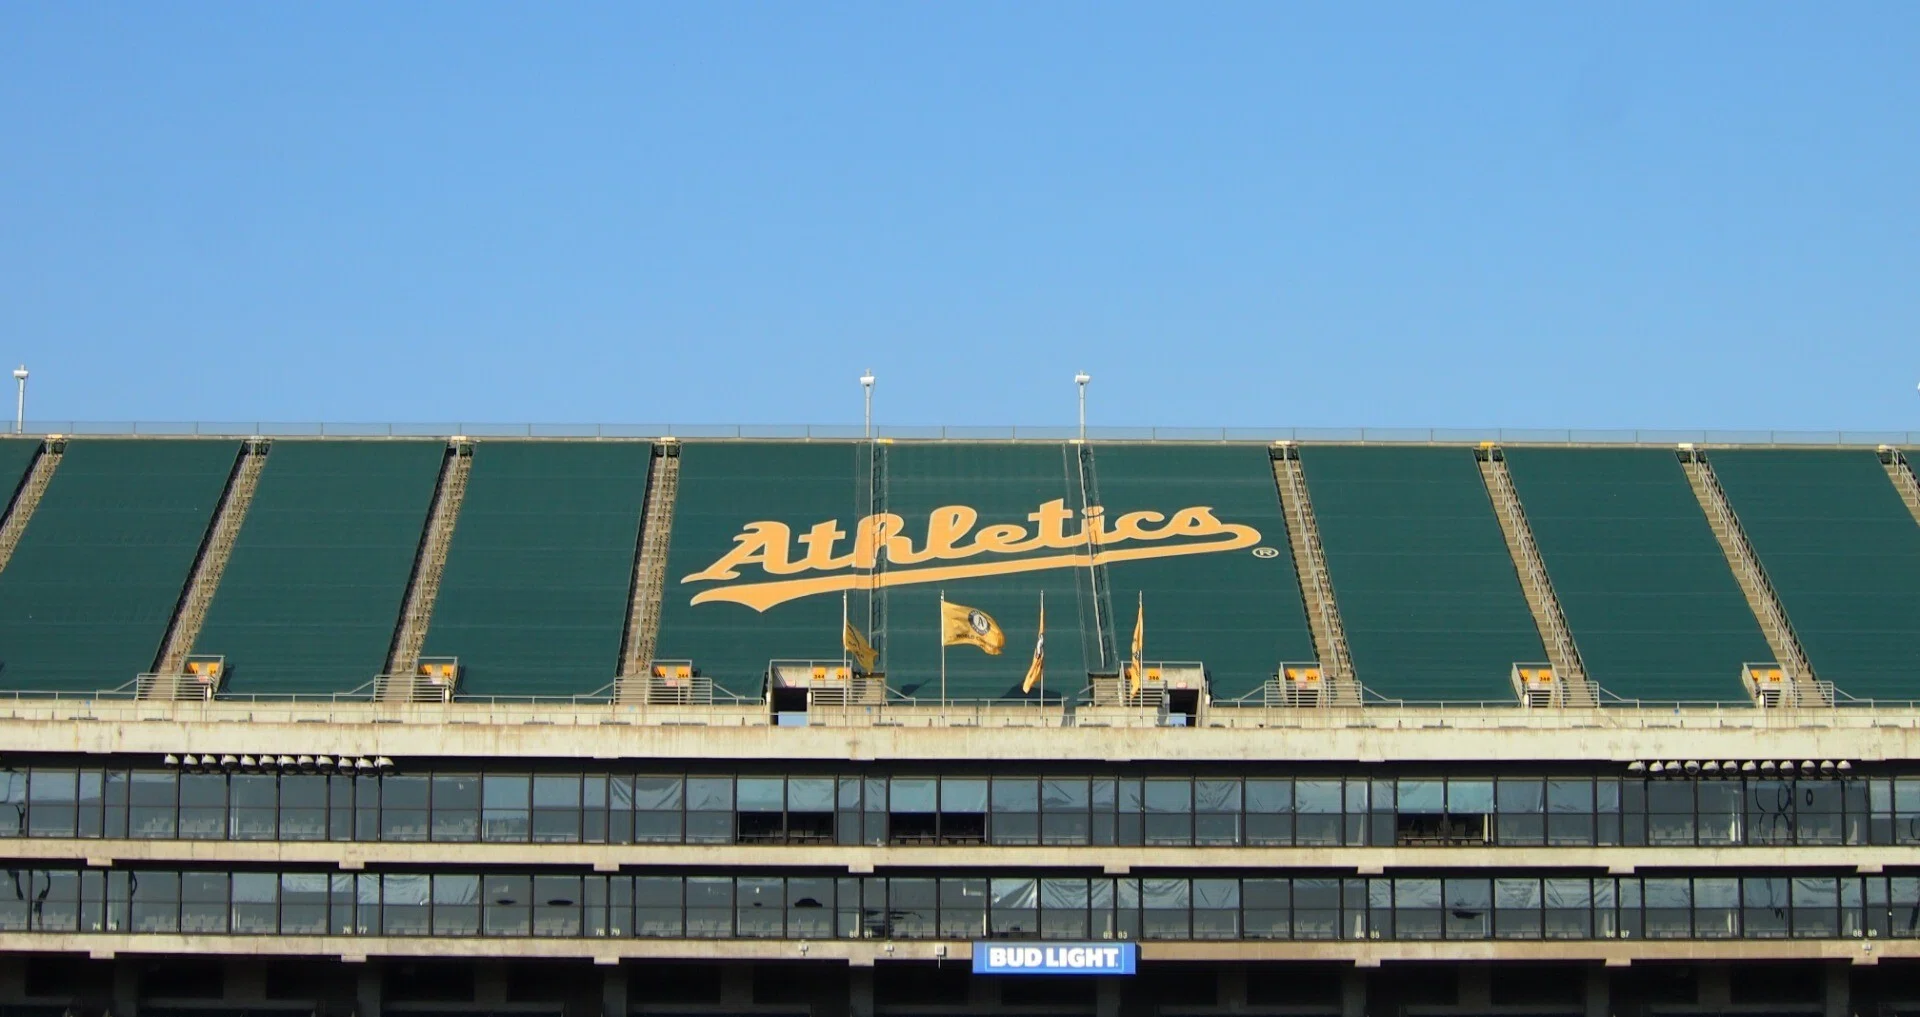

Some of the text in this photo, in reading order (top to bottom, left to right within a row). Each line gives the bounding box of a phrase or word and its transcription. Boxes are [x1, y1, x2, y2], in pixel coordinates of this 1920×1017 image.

[681, 497, 1230, 584] Athletics
[358, 926, 368, 935] 77
[989, 947, 1119, 968] BUD LIGHT
